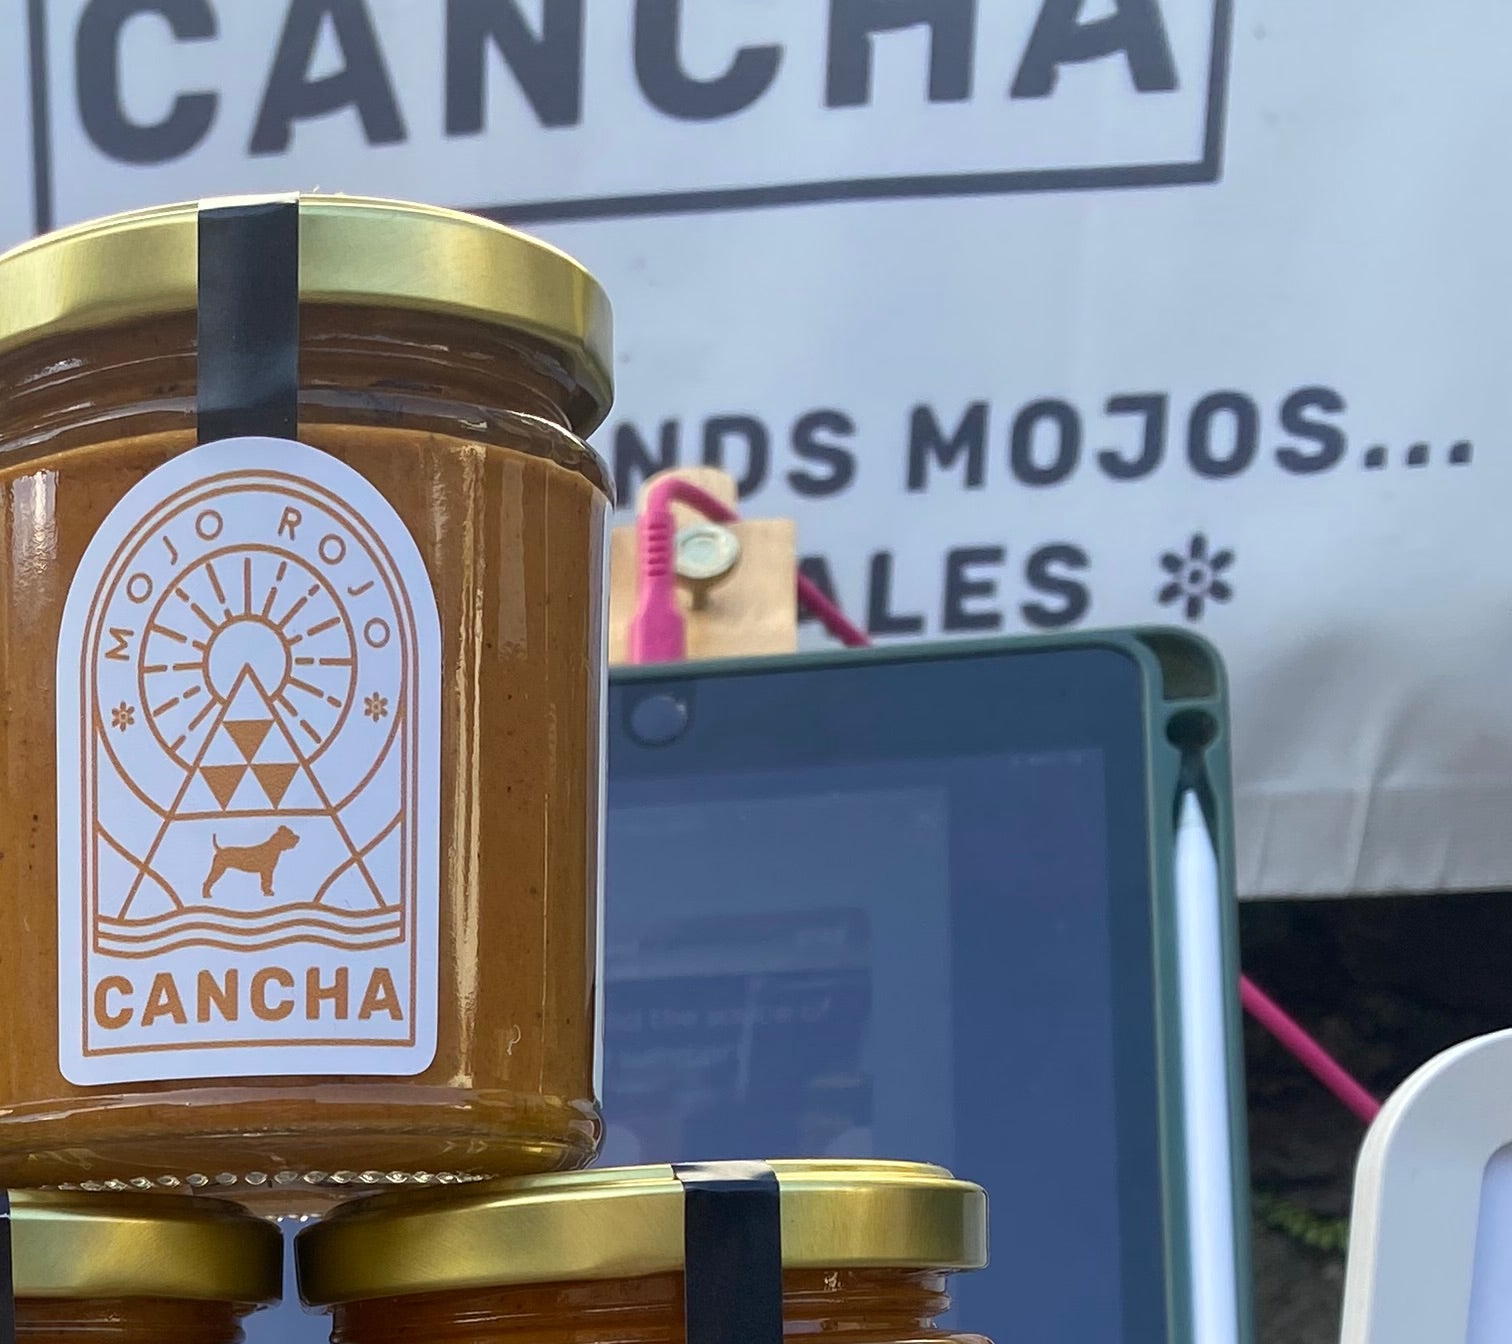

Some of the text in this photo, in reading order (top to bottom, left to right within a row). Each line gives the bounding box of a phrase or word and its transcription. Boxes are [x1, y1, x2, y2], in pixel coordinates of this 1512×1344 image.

[76, 0, 1180, 165] CANCHA
[906, 386, 1475, 491] MOJOS...
[104, 508, 224, 661] MOJO
[277, 506, 392, 649] ROJO
[93, 966, 405, 1030] CANCHA
